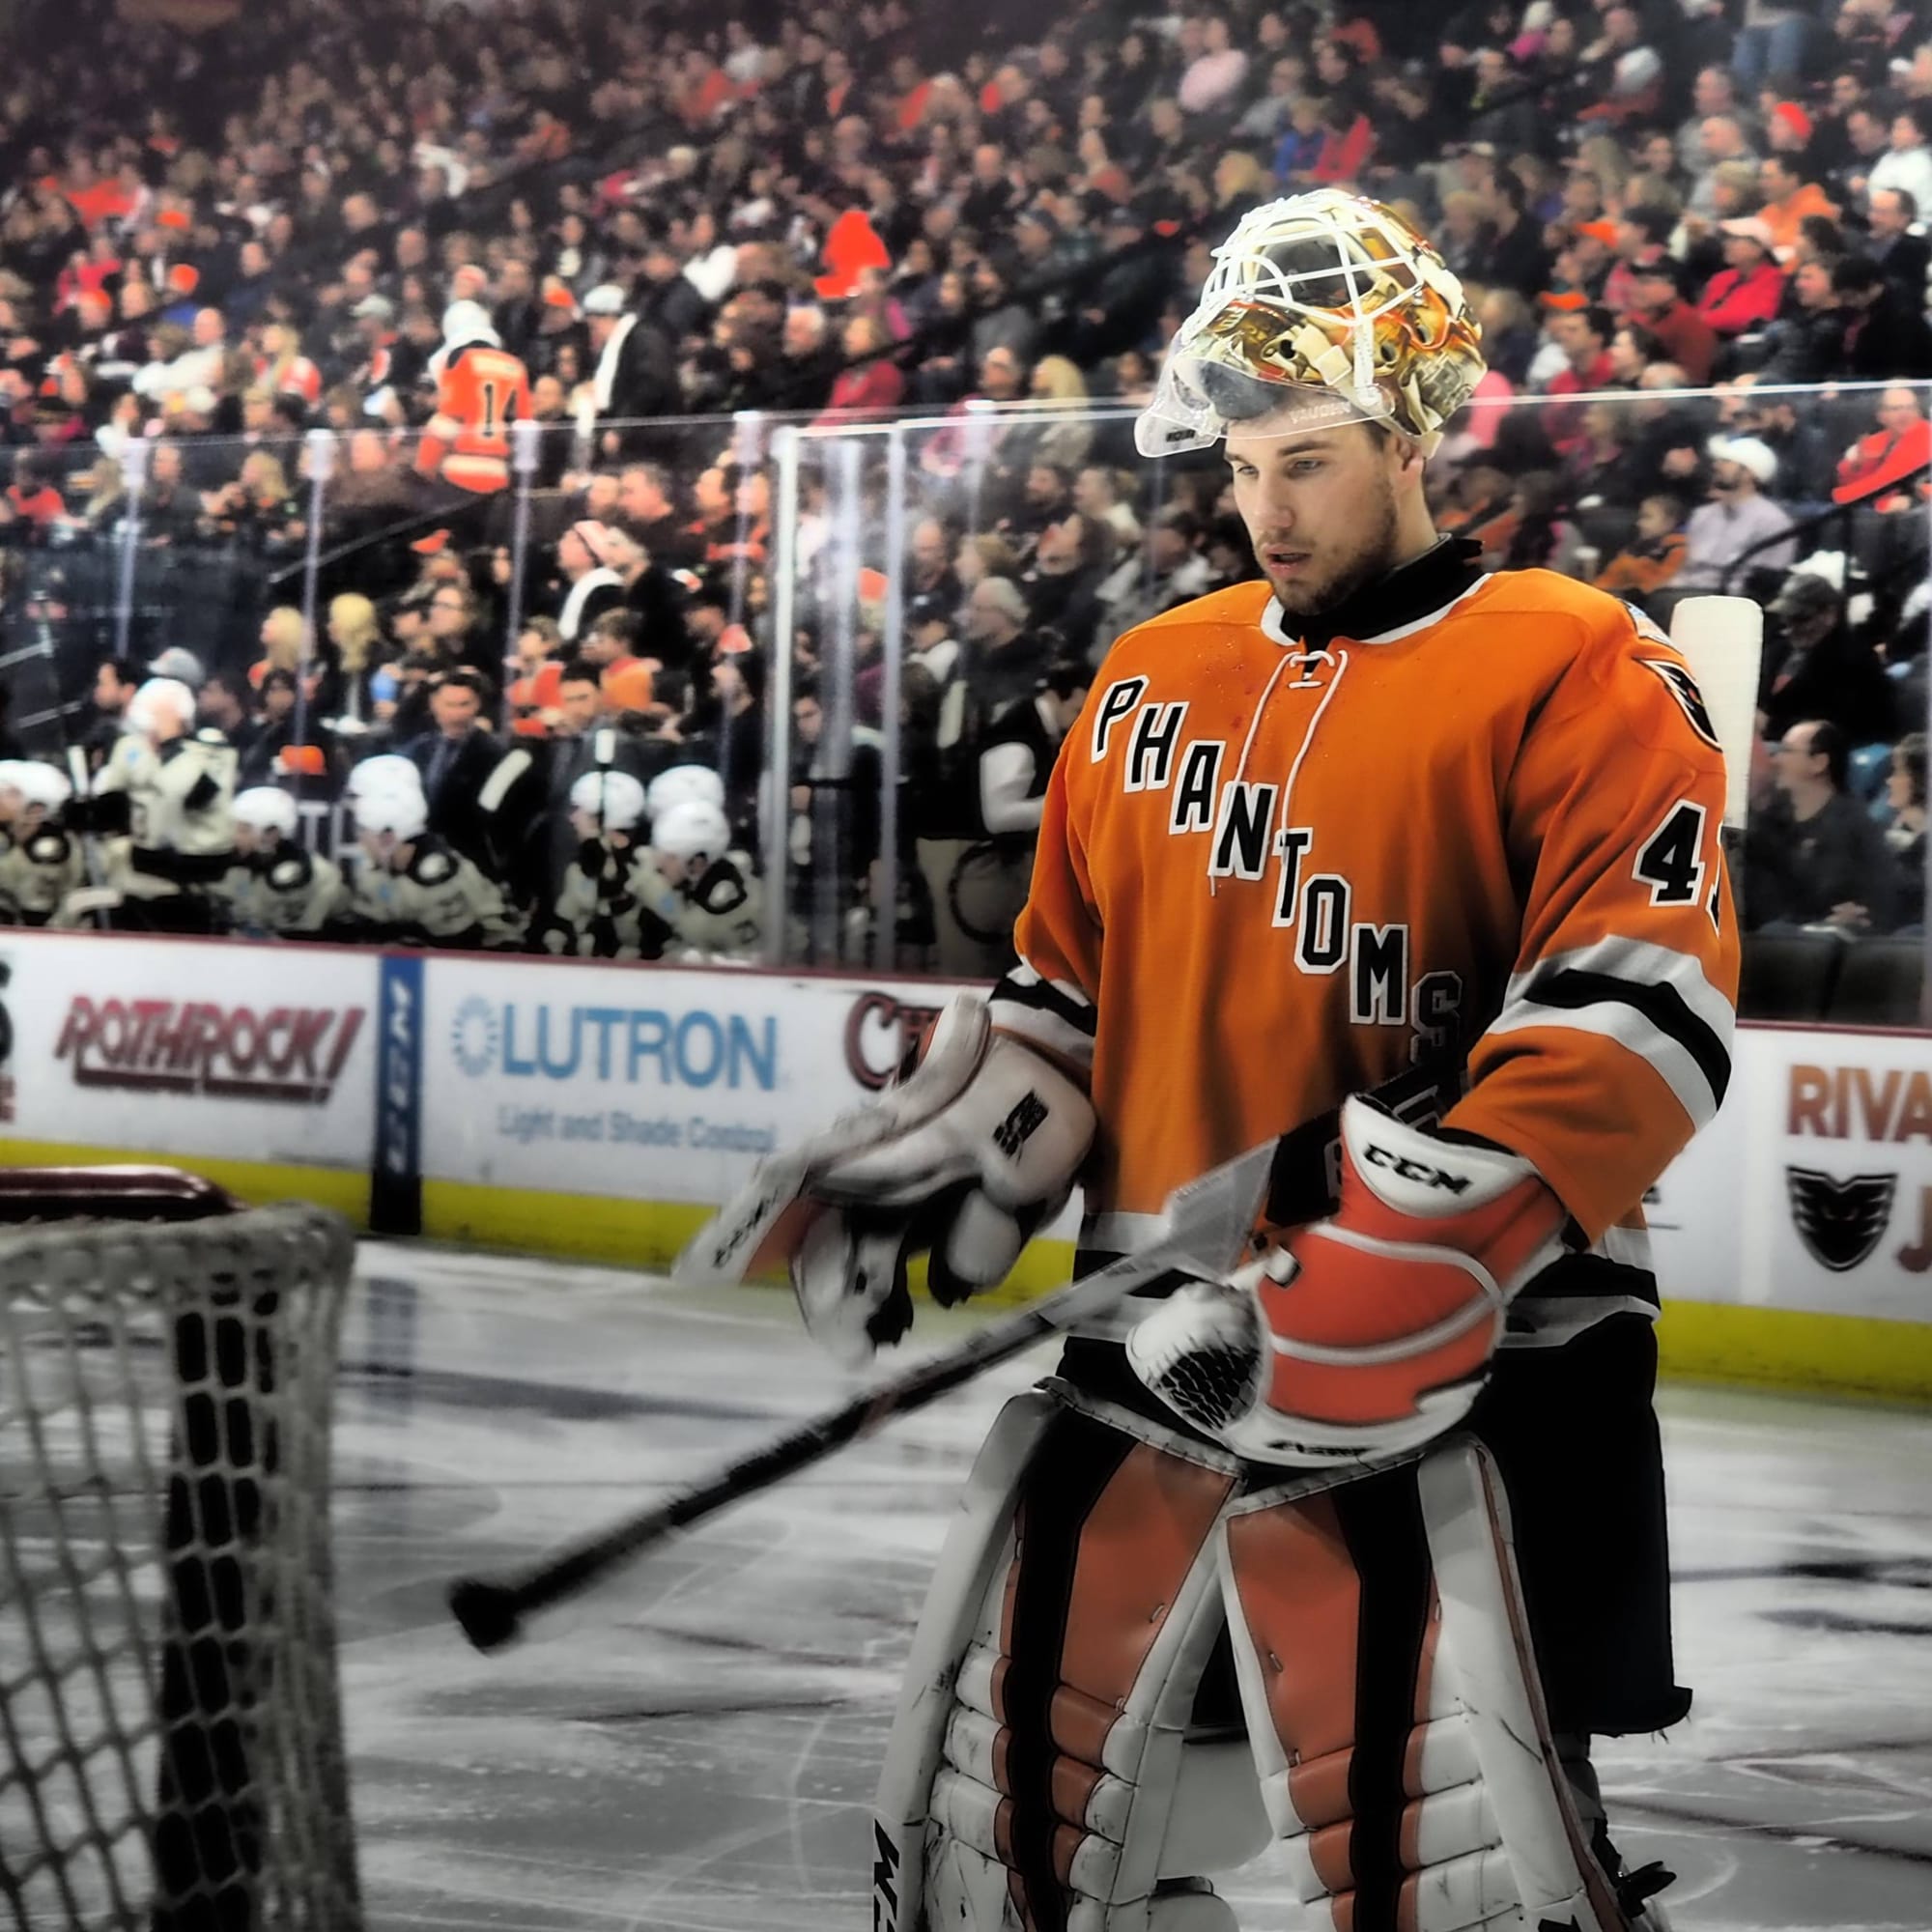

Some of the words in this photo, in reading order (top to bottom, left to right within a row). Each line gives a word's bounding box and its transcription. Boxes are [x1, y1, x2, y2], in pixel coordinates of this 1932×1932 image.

[1091, 674, 1463, 1065] PHANTOMS
[1632, 799, 1721, 939] 4
[500, 1003, 775, 1092] LUTRON
